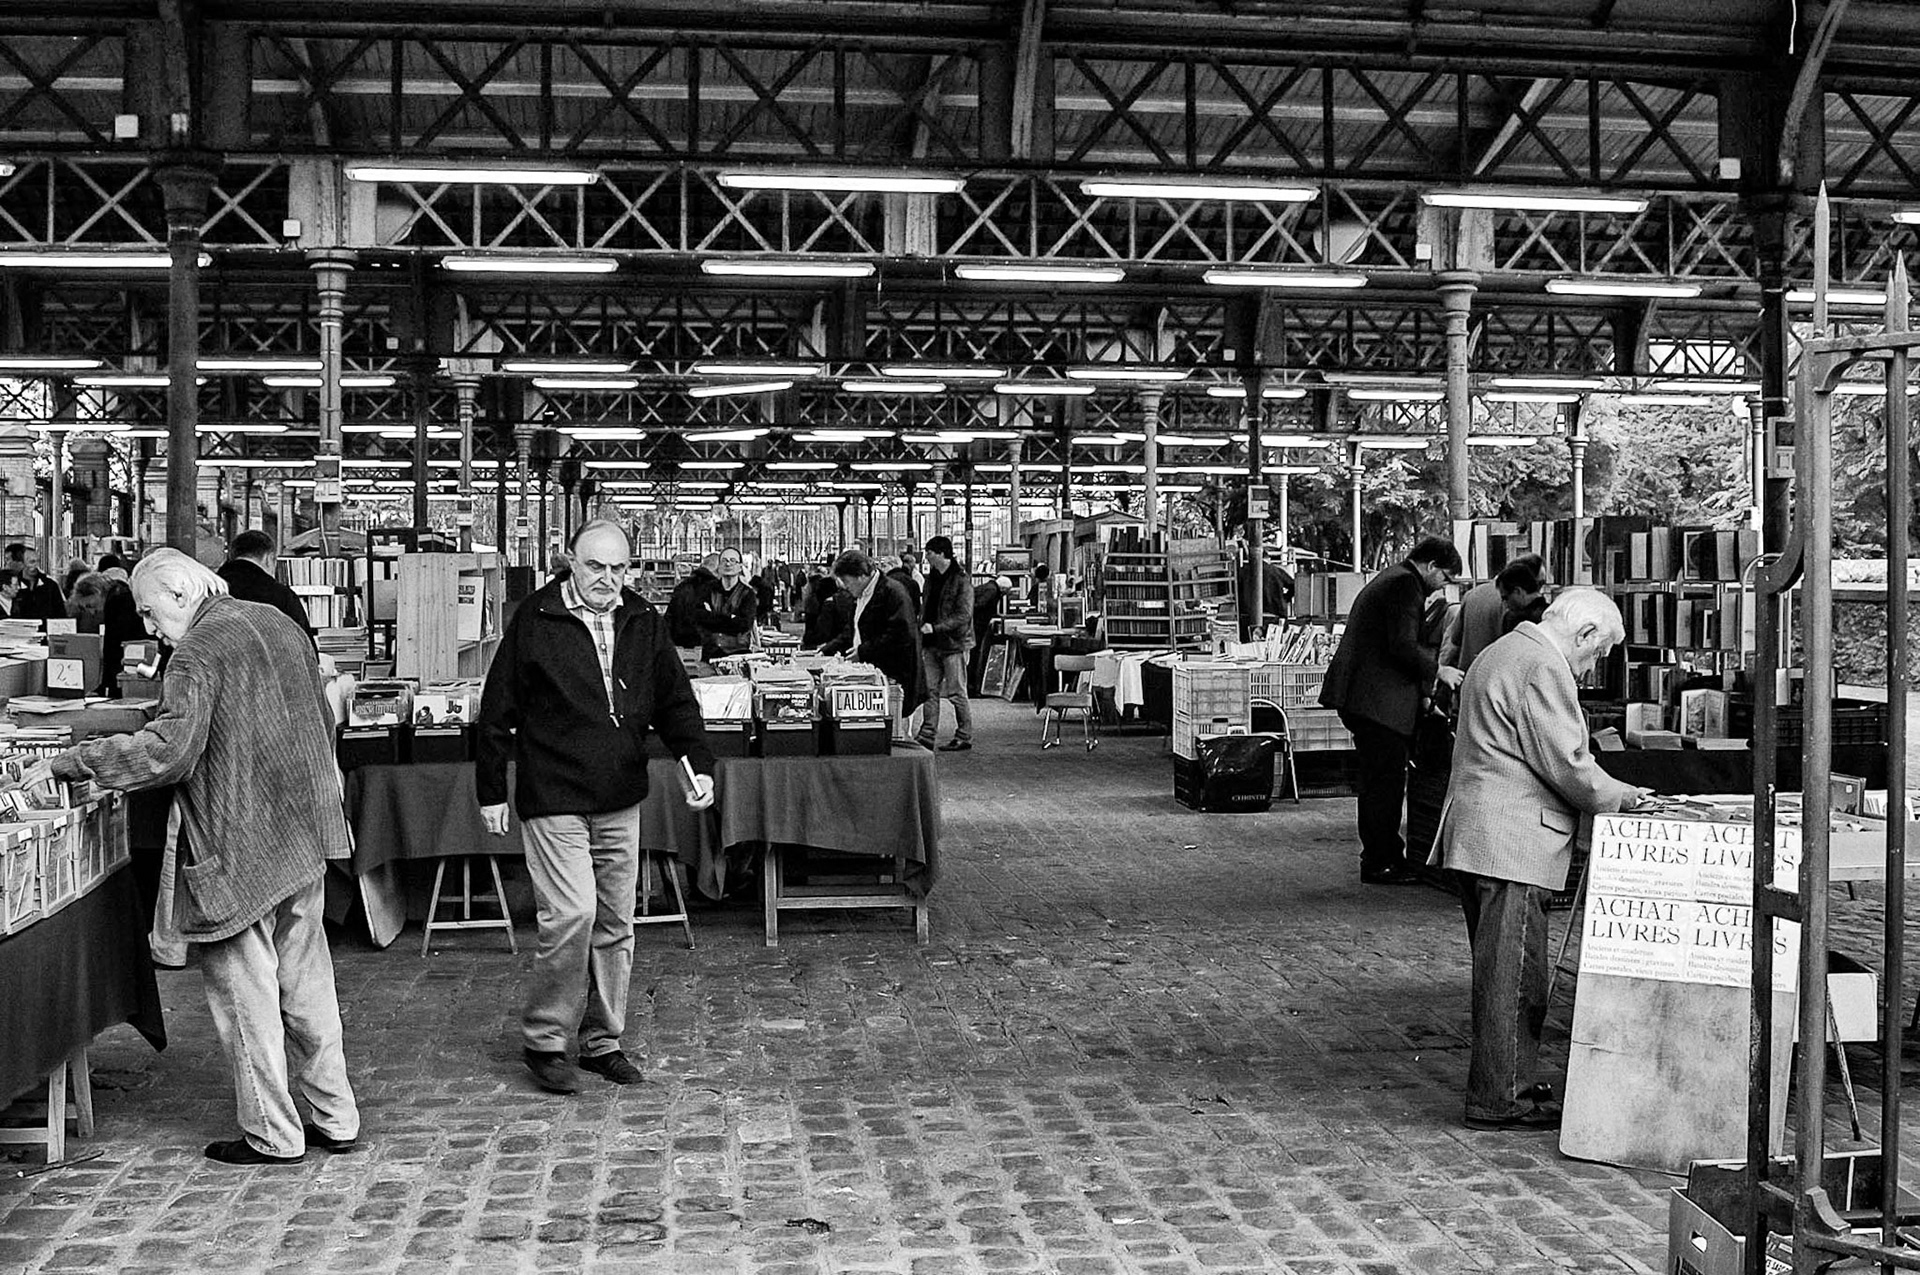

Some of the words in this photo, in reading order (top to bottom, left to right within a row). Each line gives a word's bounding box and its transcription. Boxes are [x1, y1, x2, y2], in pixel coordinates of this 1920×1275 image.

[1599, 819, 1689, 842] ACHAT
[1703, 824, 1795, 849] ACHT
[1598, 841, 1689, 865] LIVRES
[1591, 897, 1680, 922] ACHAT
[1590, 920, 1680, 945] LIVRES
[1693, 928, 1787, 955] LIVRS
